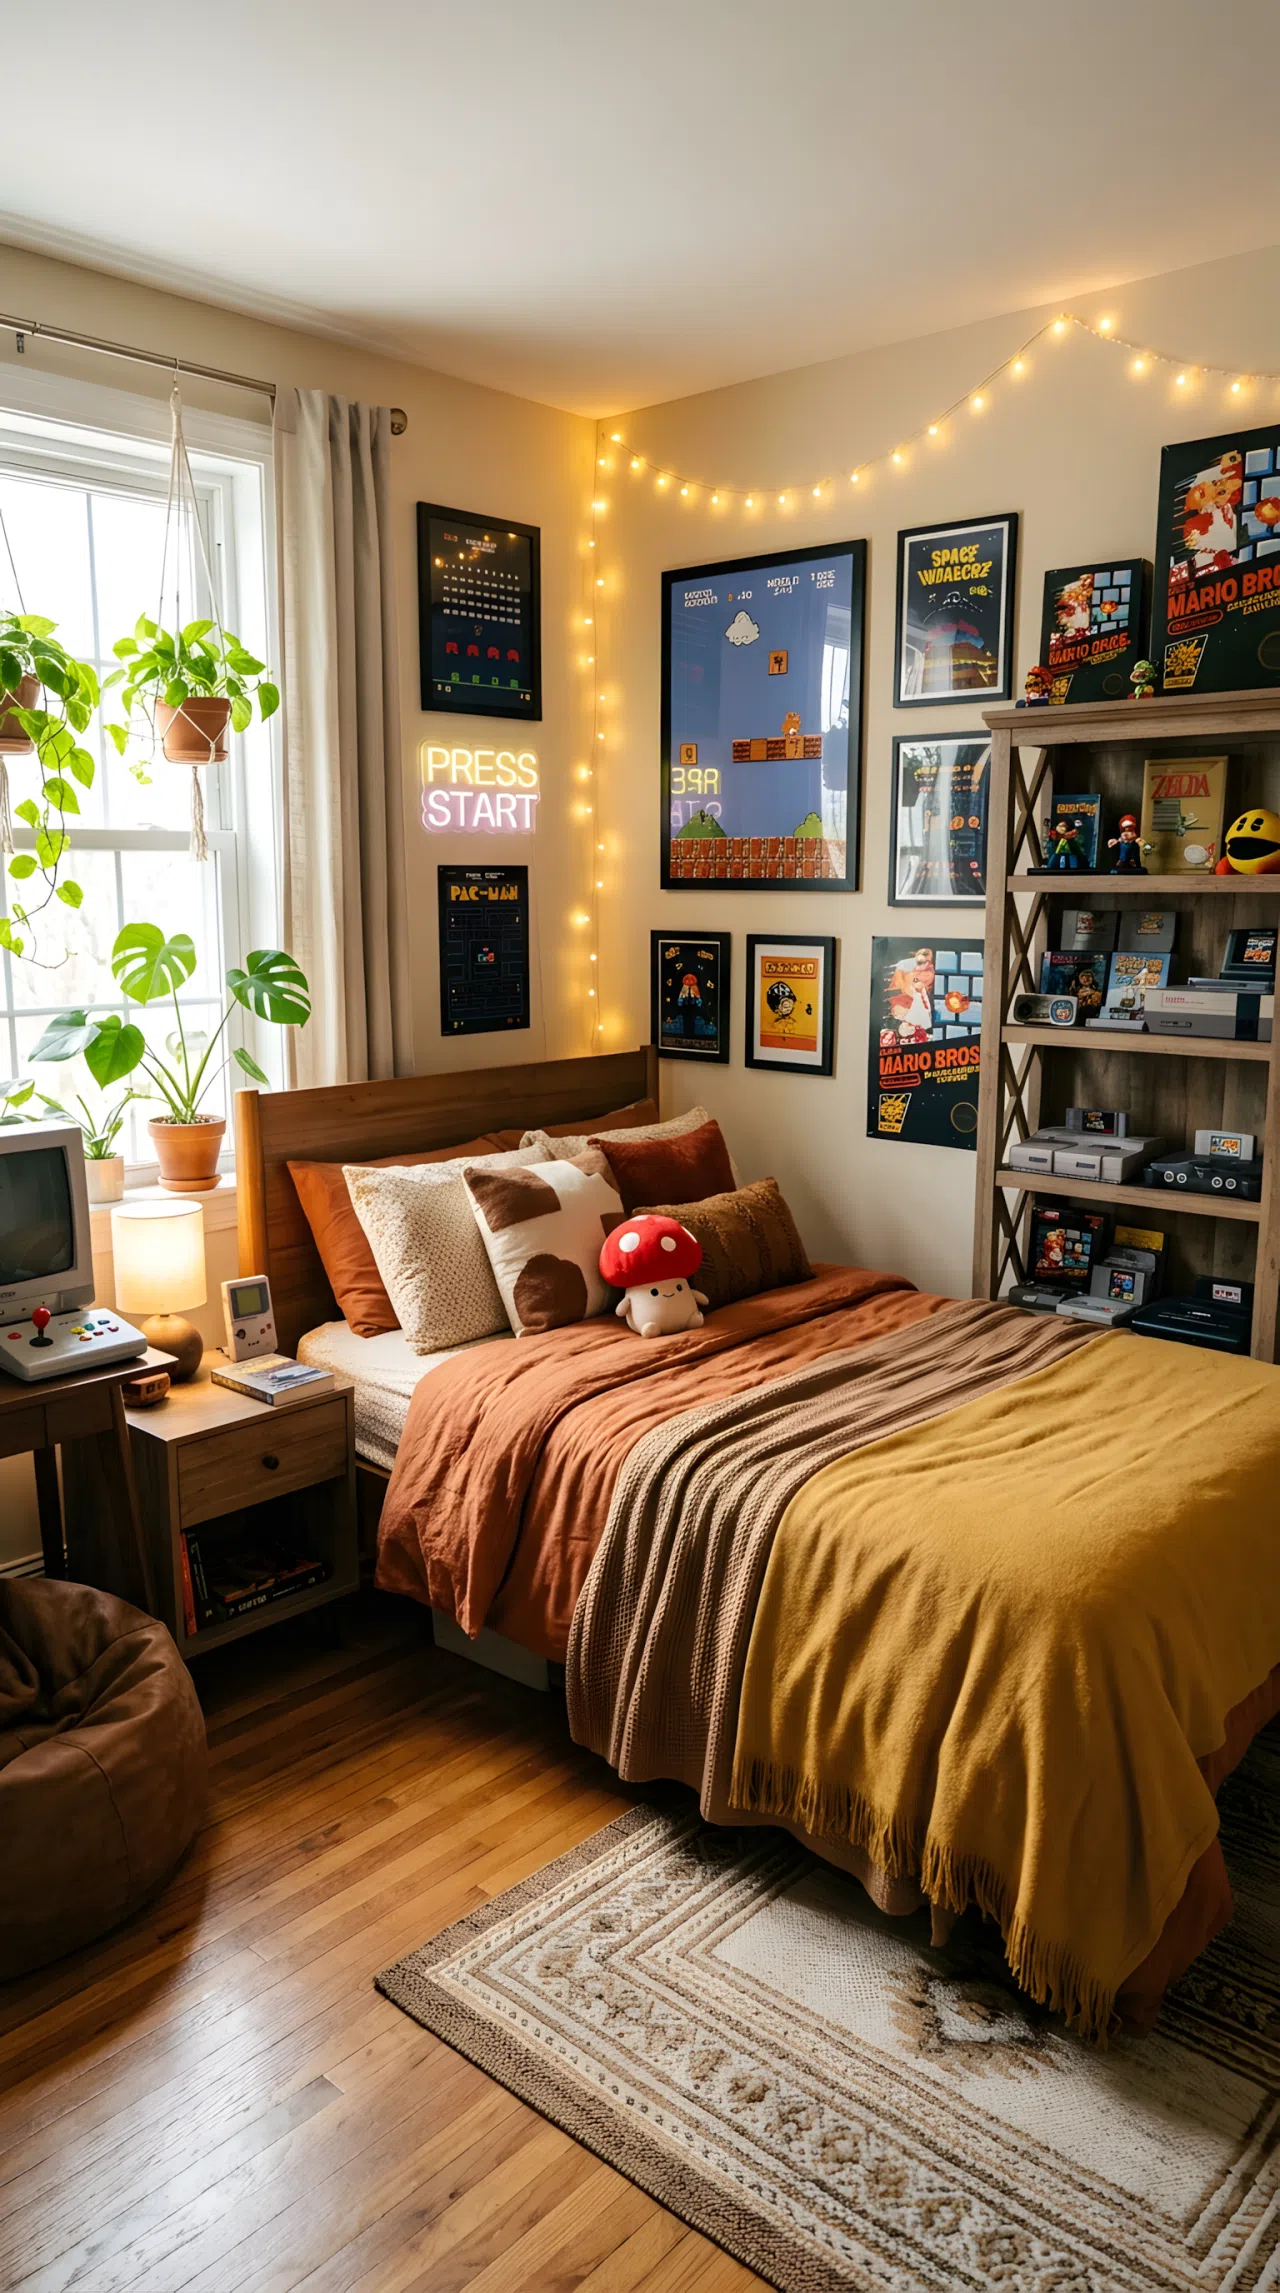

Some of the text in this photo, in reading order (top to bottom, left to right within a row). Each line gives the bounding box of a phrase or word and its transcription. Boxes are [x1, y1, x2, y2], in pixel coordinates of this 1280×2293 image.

[931, 544, 979, 568] SPACE
[1167, 578, 1238, 620] MARIO
[427, 747, 538, 788] PRESS
[1151, 773, 1210, 799] ZELDA
[427, 789, 538, 829] START
[935, 1045, 980, 1068] BROS
